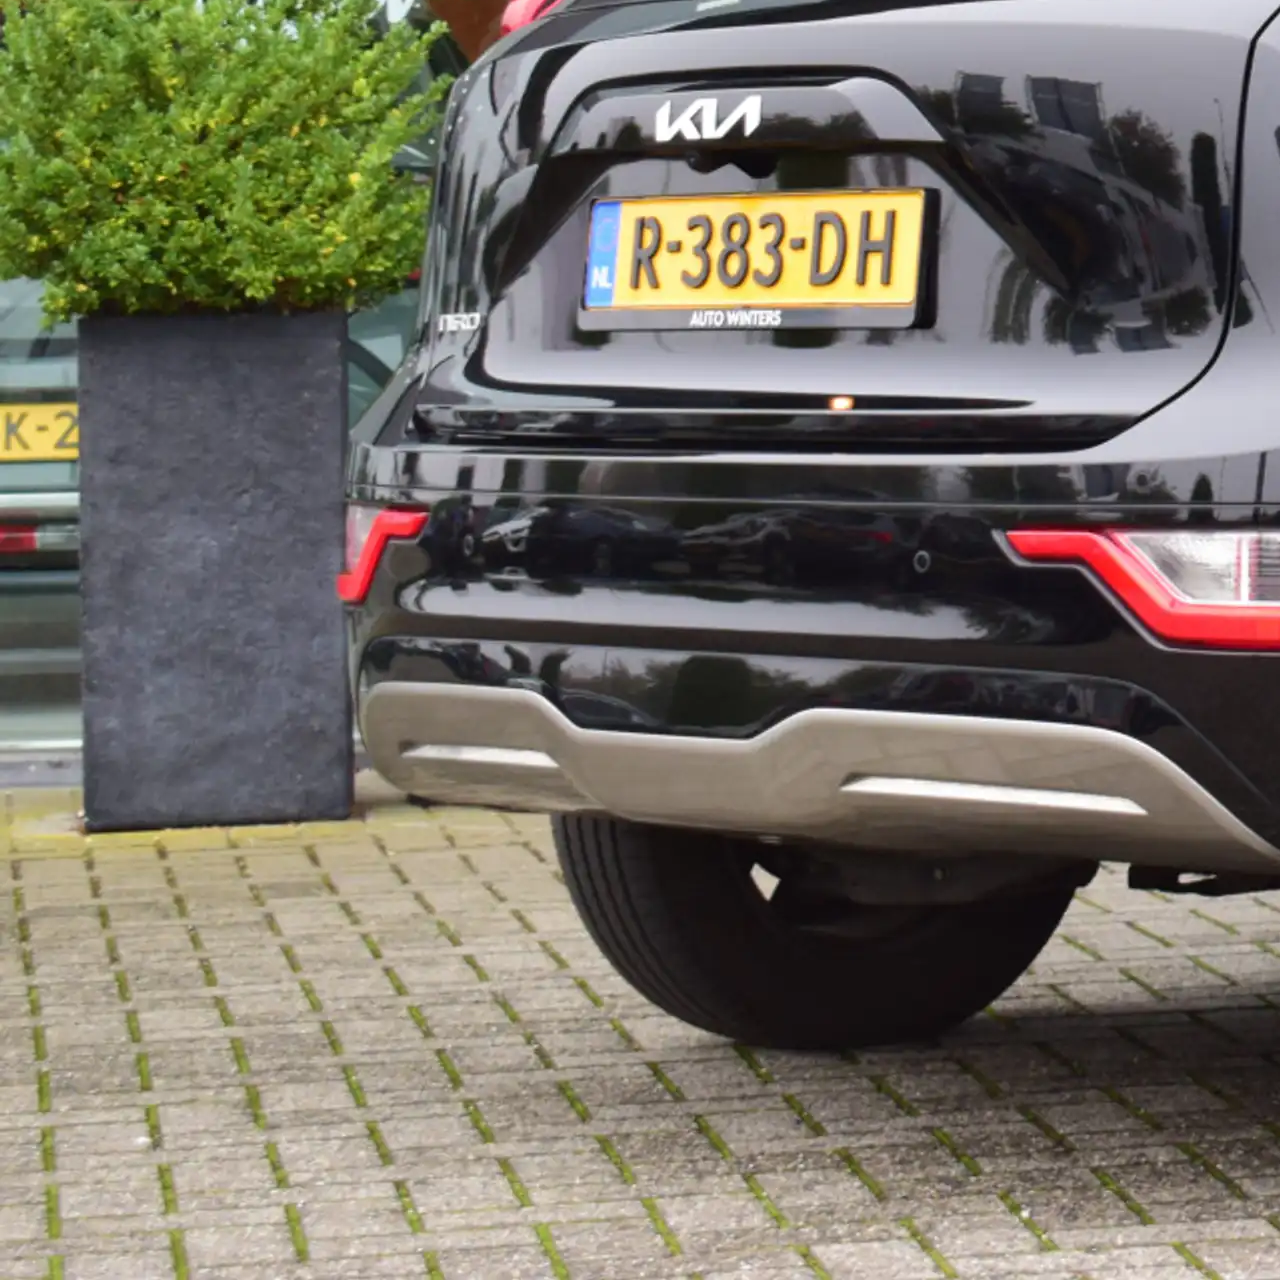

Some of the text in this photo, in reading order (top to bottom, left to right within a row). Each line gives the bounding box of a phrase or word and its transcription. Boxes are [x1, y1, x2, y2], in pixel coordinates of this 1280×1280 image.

[655, 95, 762, 142] KIA
[629, 209, 897, 289] R-383-DH
[591, 265, 613, 289] NL
[689, 310, 782, 326] AUTO WINTERS
